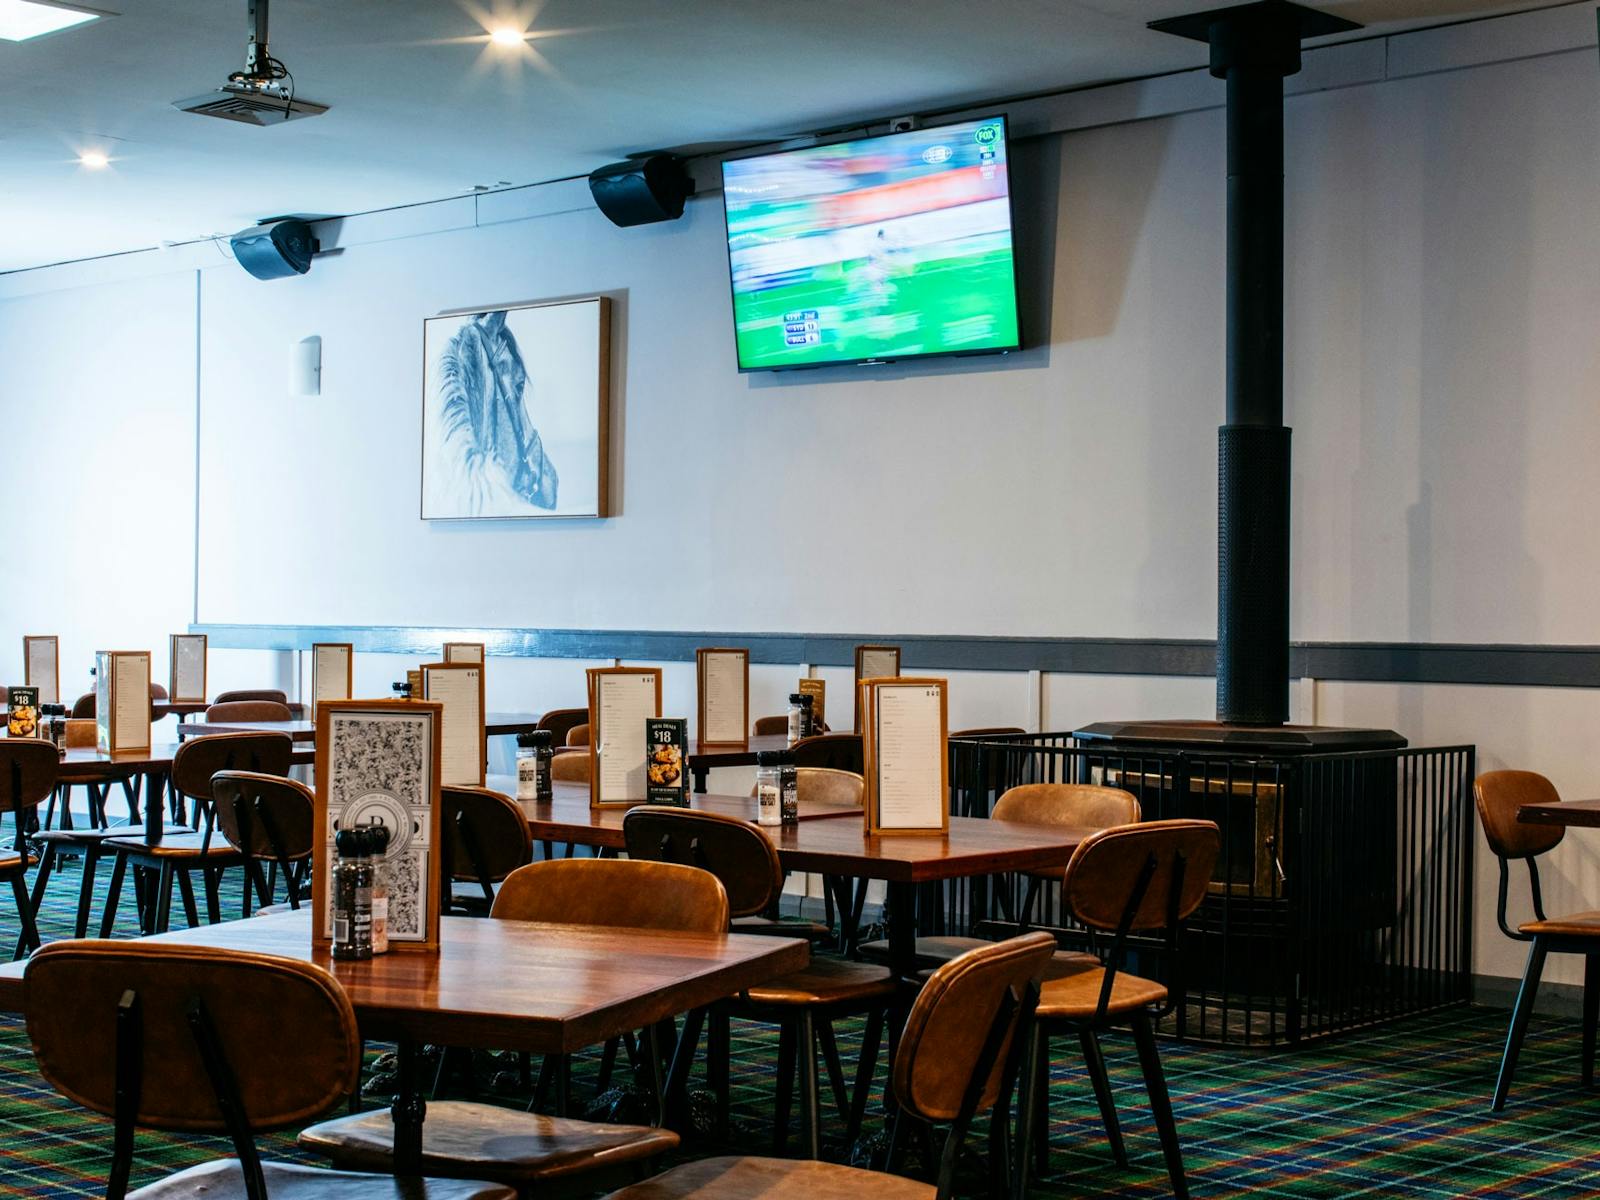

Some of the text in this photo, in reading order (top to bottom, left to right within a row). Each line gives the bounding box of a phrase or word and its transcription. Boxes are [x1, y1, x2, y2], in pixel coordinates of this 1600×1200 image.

[979, 129, 994, 141] FOX
[14, 695, 29, 705] $18
[654, 730, 672, 743] $18
